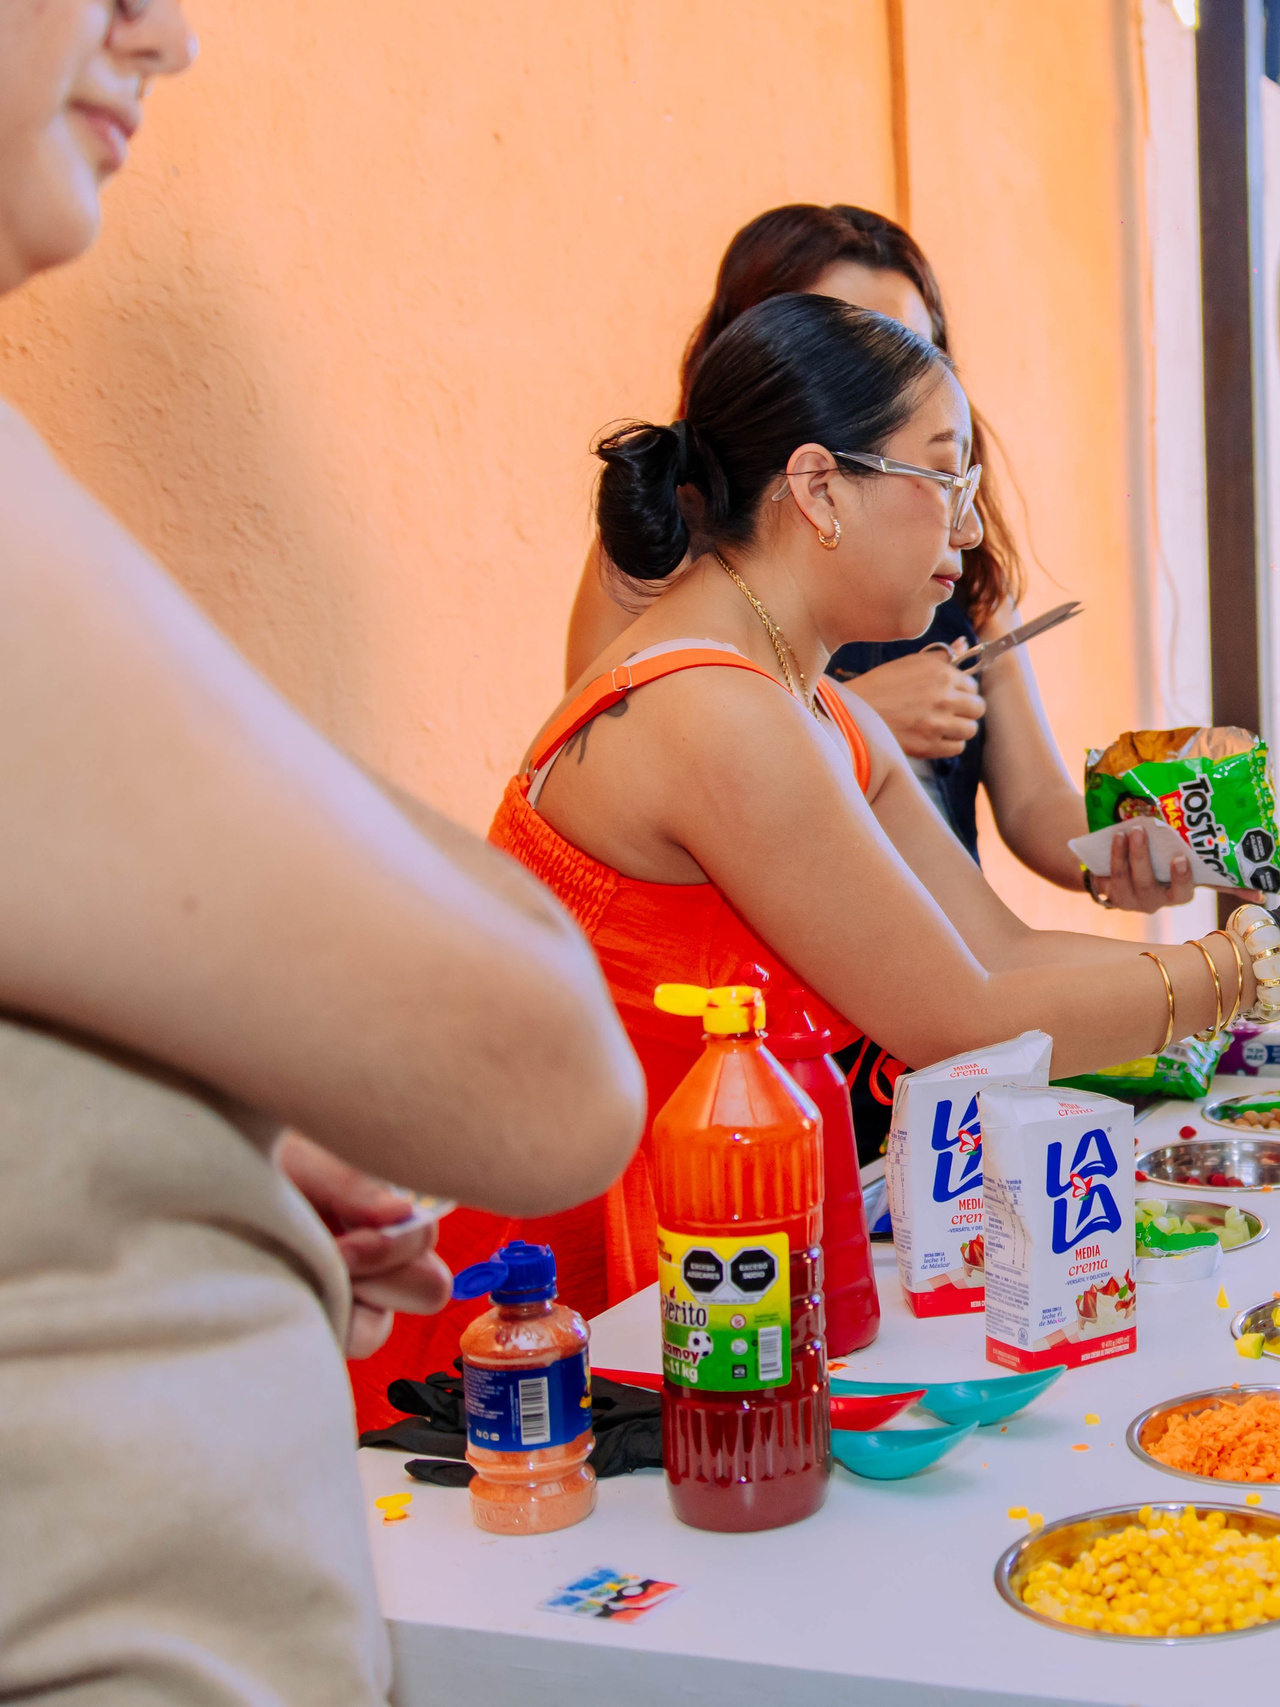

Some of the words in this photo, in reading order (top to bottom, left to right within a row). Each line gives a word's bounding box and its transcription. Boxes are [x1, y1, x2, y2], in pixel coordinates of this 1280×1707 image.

[1163, 797, 1182, 829] MÁS
[1182, 777, 1236, 881] TOSTITO
[950, 1067, 988, 1078] crema
[953, 1063, 979, 1071] MEDIA
[1058, 1108, 1094, 1116] crema
[951, 1212, 983, 1225] crem
[1076, 1245, 1101, 1261] MEDIA
[690, 1263, 716, 1272] EXCESO
[739, 1262, 768, 1271] EXCESO
[1068, 1258, 1108, 1277] crema
[743, 1271, 765, 1280] SODIO
[682, 1362, 698, 1384] kg
